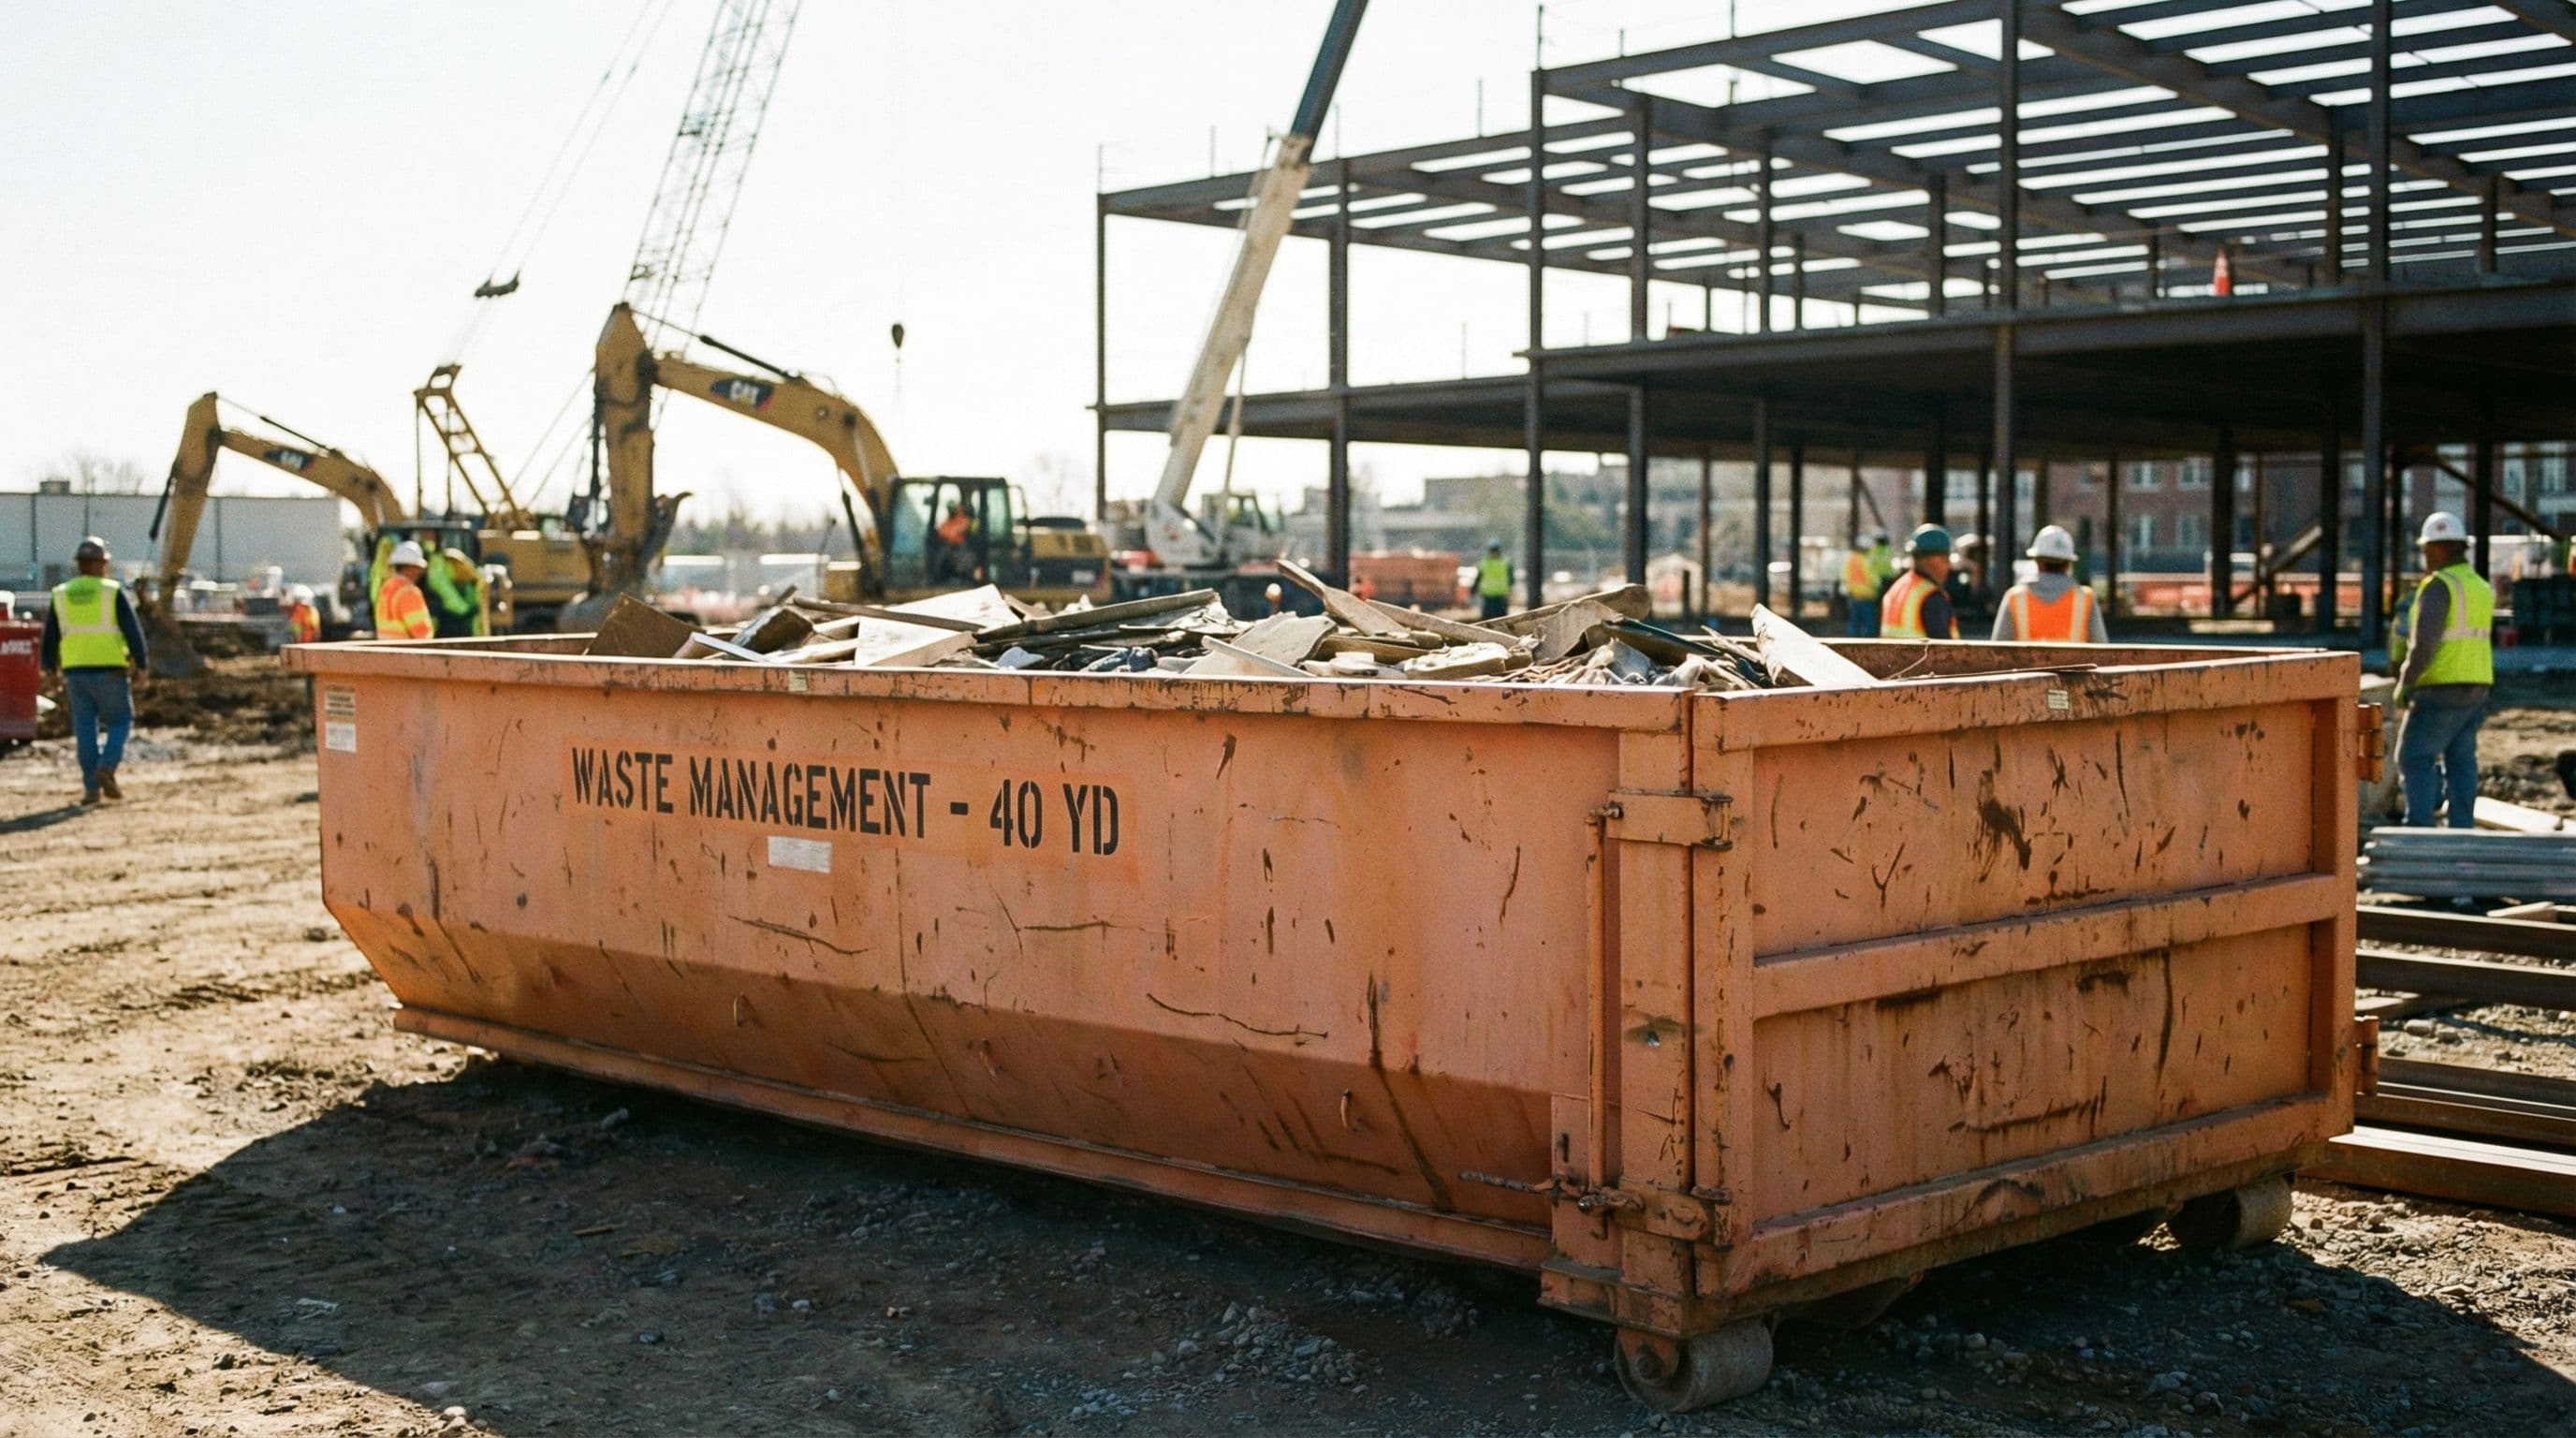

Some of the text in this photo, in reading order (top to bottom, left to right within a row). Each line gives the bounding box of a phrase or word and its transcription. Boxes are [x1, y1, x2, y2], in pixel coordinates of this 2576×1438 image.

[729, 379, 760, 405] CAT
[572, 747, 1120, 856] WASTE MANAGEMENT - 40 YD
